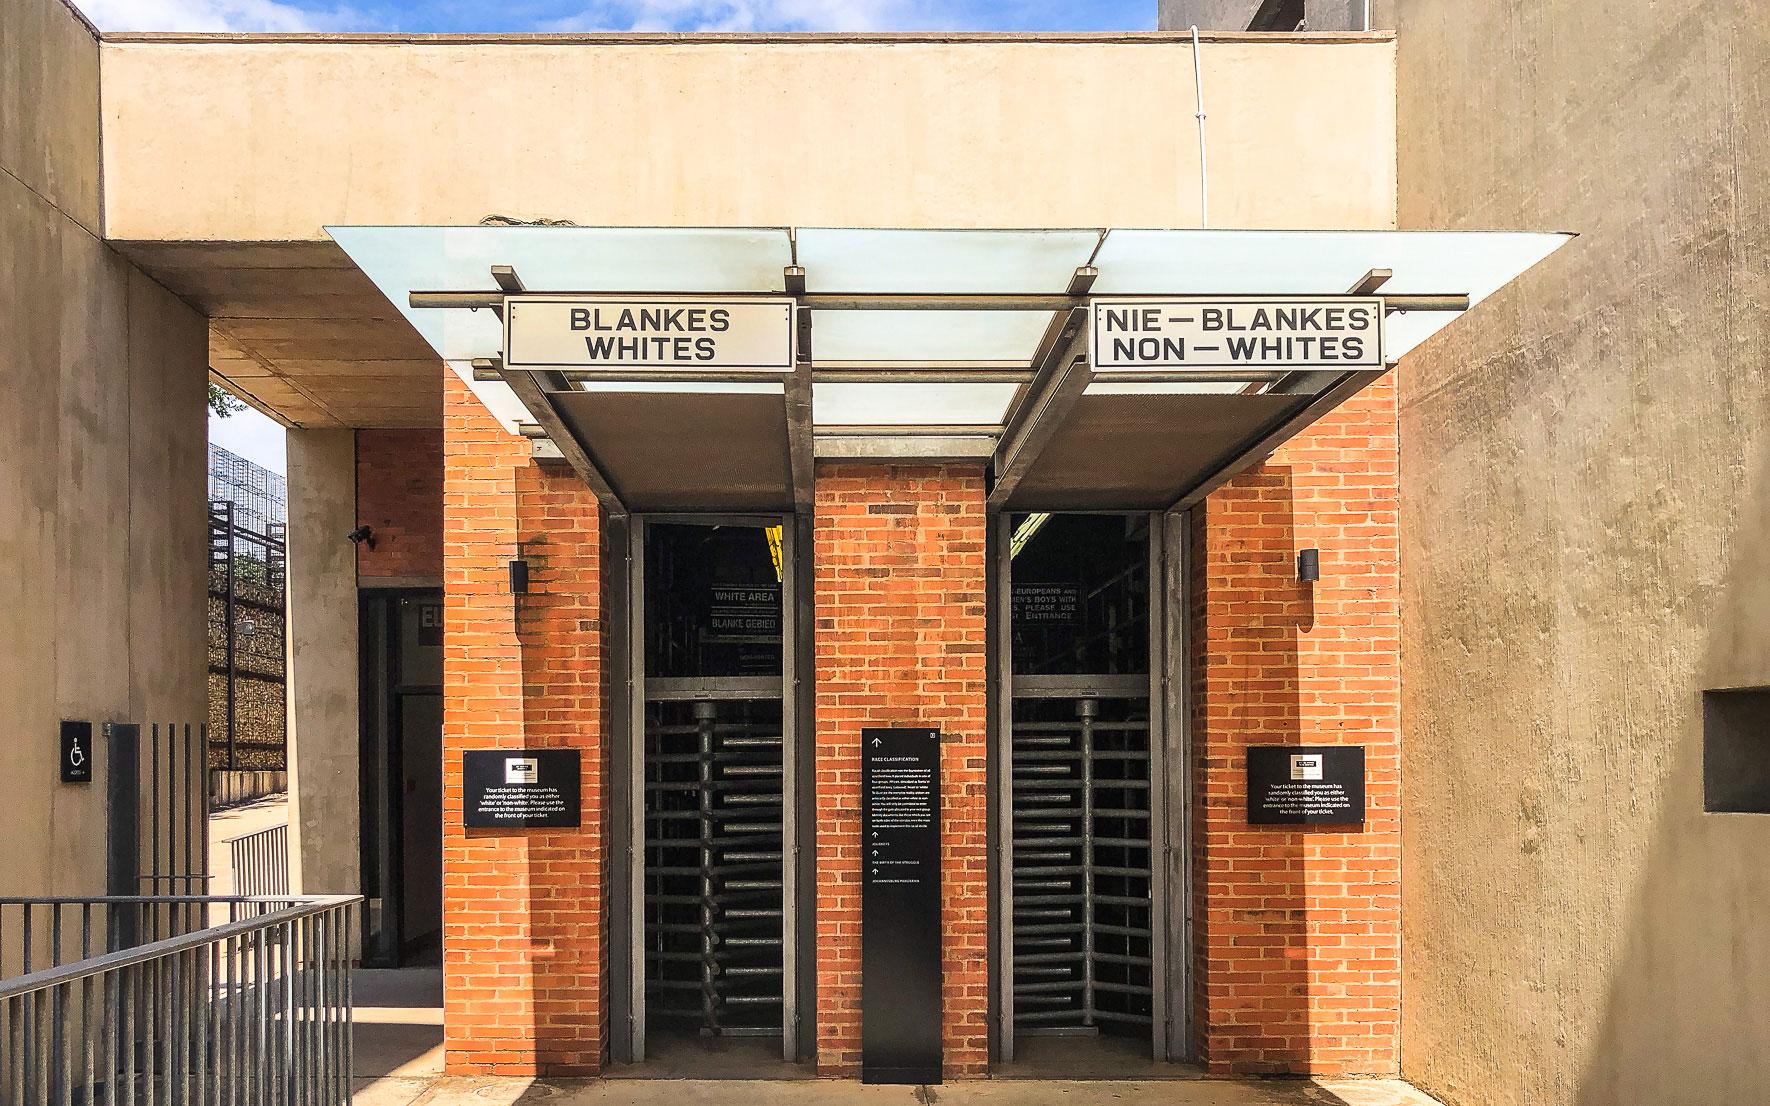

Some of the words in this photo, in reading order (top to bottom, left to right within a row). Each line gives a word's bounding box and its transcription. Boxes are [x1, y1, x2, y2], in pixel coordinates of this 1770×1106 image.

[570, 308, 730, 332] BLANKES
[585, 336, 716, 360] WHITES
[715, 592, 746, 601] WHITE
[748, 592, 775, 601] AREA
[712, 619, 744, 628] BLANKE
[745, 619, 775, 628] GEBIED
